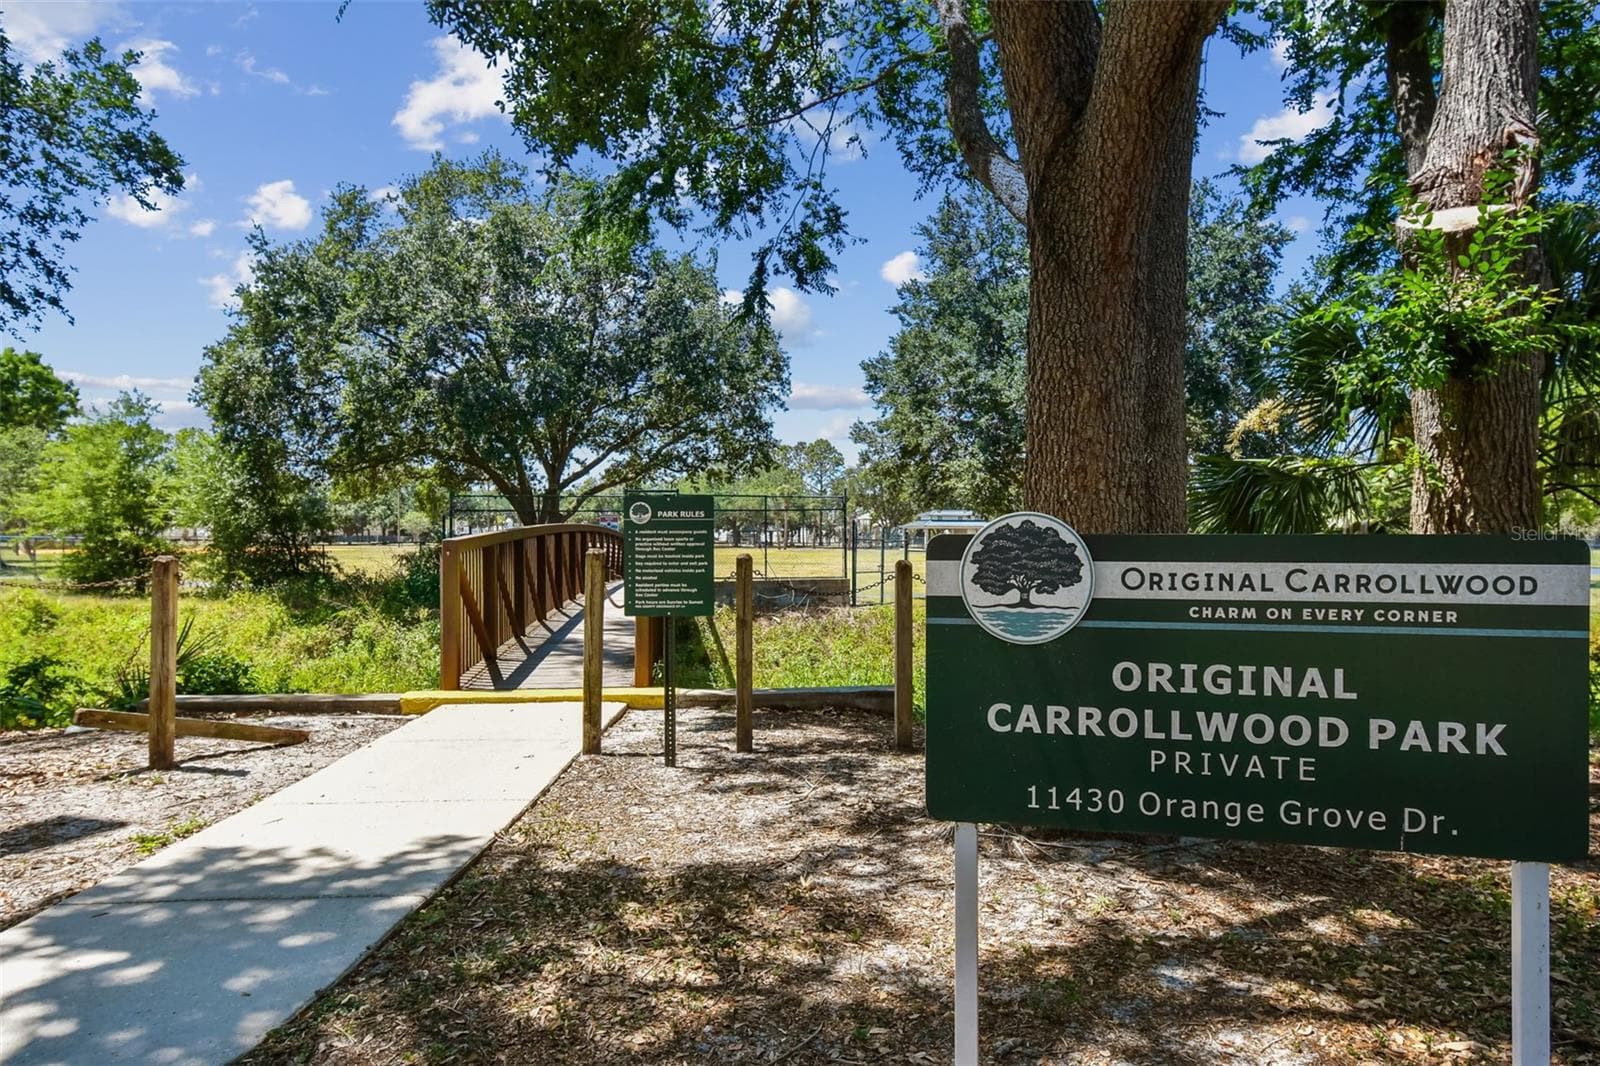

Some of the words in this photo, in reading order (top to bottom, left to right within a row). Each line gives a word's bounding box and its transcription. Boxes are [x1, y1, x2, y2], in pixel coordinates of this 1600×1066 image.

[657, 510, 679, 518] PARK
[680, 510, 705, 518] RULES
[1120, 566, 1275, 593] ORIGINAL
[1285, 568, 1539, 596] CARROLLWOOD
[1188, 606, 1258, 620] CHARM
[1266, 607, 1293, 620] ON
[1302, 608, 1365, 621] EVERY
[1373, 609, 1459, 623] CORNER
[1111, 660, 1358, 700] ORIGINAL
[986, 703, 1350, 748] CARROLLWOOD
[1368, 718, 1509, 757] PARK
[1150, 749, 1317, 782] PRIVATE
[1026, 784, 1126, 814] 11430
[1138, 791, 1265, 828] Orange
[1279, 799, 1387, 831] Grove
[1403, 807, 1459, 836] Dr.
